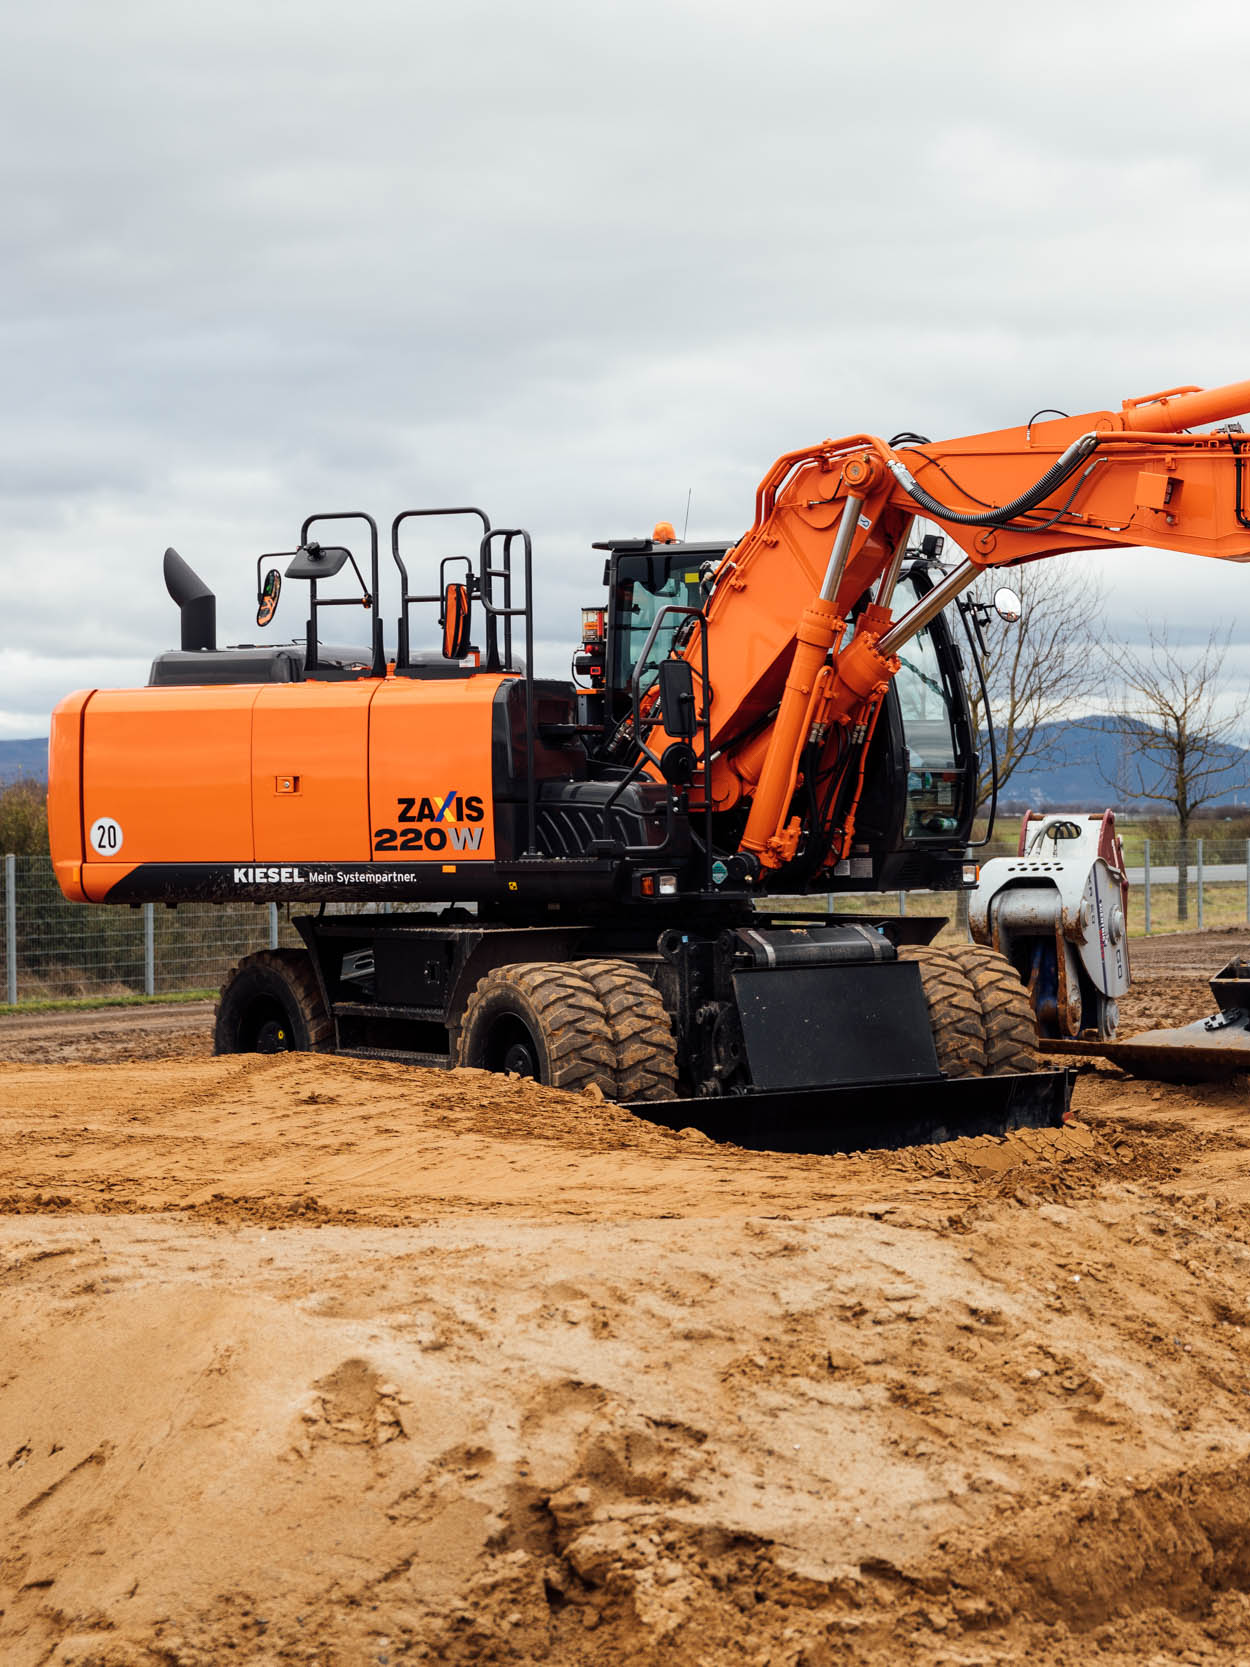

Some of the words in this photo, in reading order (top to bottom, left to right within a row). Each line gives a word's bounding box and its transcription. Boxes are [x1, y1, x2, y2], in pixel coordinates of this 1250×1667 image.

[397, 790, 484, 822] ZAXIS
[97, 824, 117, 849] 20
[374, 827, 484, 851] 220W
[233, 867, 304, 883] KIESEL
[309, 872, 334, 883] Mein
[336, 871, 417, 885] Systempartner.
